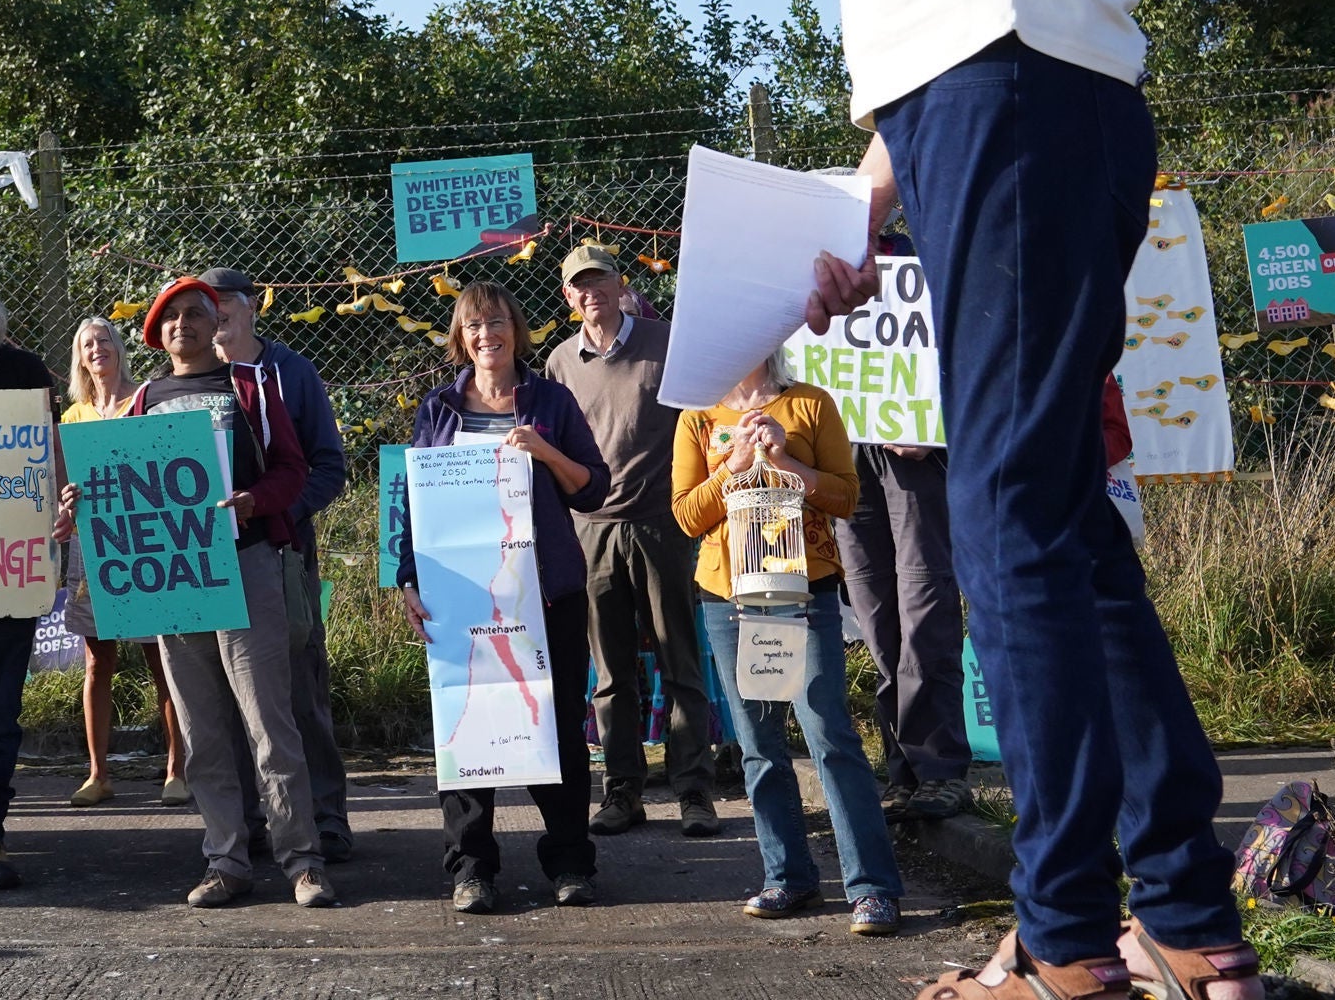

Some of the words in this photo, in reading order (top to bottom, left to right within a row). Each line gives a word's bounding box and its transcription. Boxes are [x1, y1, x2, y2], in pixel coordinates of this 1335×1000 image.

[405, 170, 520, 194] WHITEHAVEN
[407, 185, 522, 212] DESERVES
[408, 203, 524, 234] BETTER
[1259, 244, 1310, 261] 4,500
[1257, 259, 1317, 276] GREEN
[1267, 275, 1312, 292] JOBS
[844, 310, 933, 348] COA
[437, 450, 477, 459] PROJECTED
[442, 468, 467, 476] 2050
[84, 457, 209, 514] #NO
[90, 507, 216, 557] NEW
[501, 540, 533, 549] Parton
[99, 551, 230, 596] COAL
[35, 624, 72, 640] COA
[470, 624, 527, 636] Whitehaven
[34, 635, 80, 655] JOBS?
[459, 766, 505, 777] Sandwith
